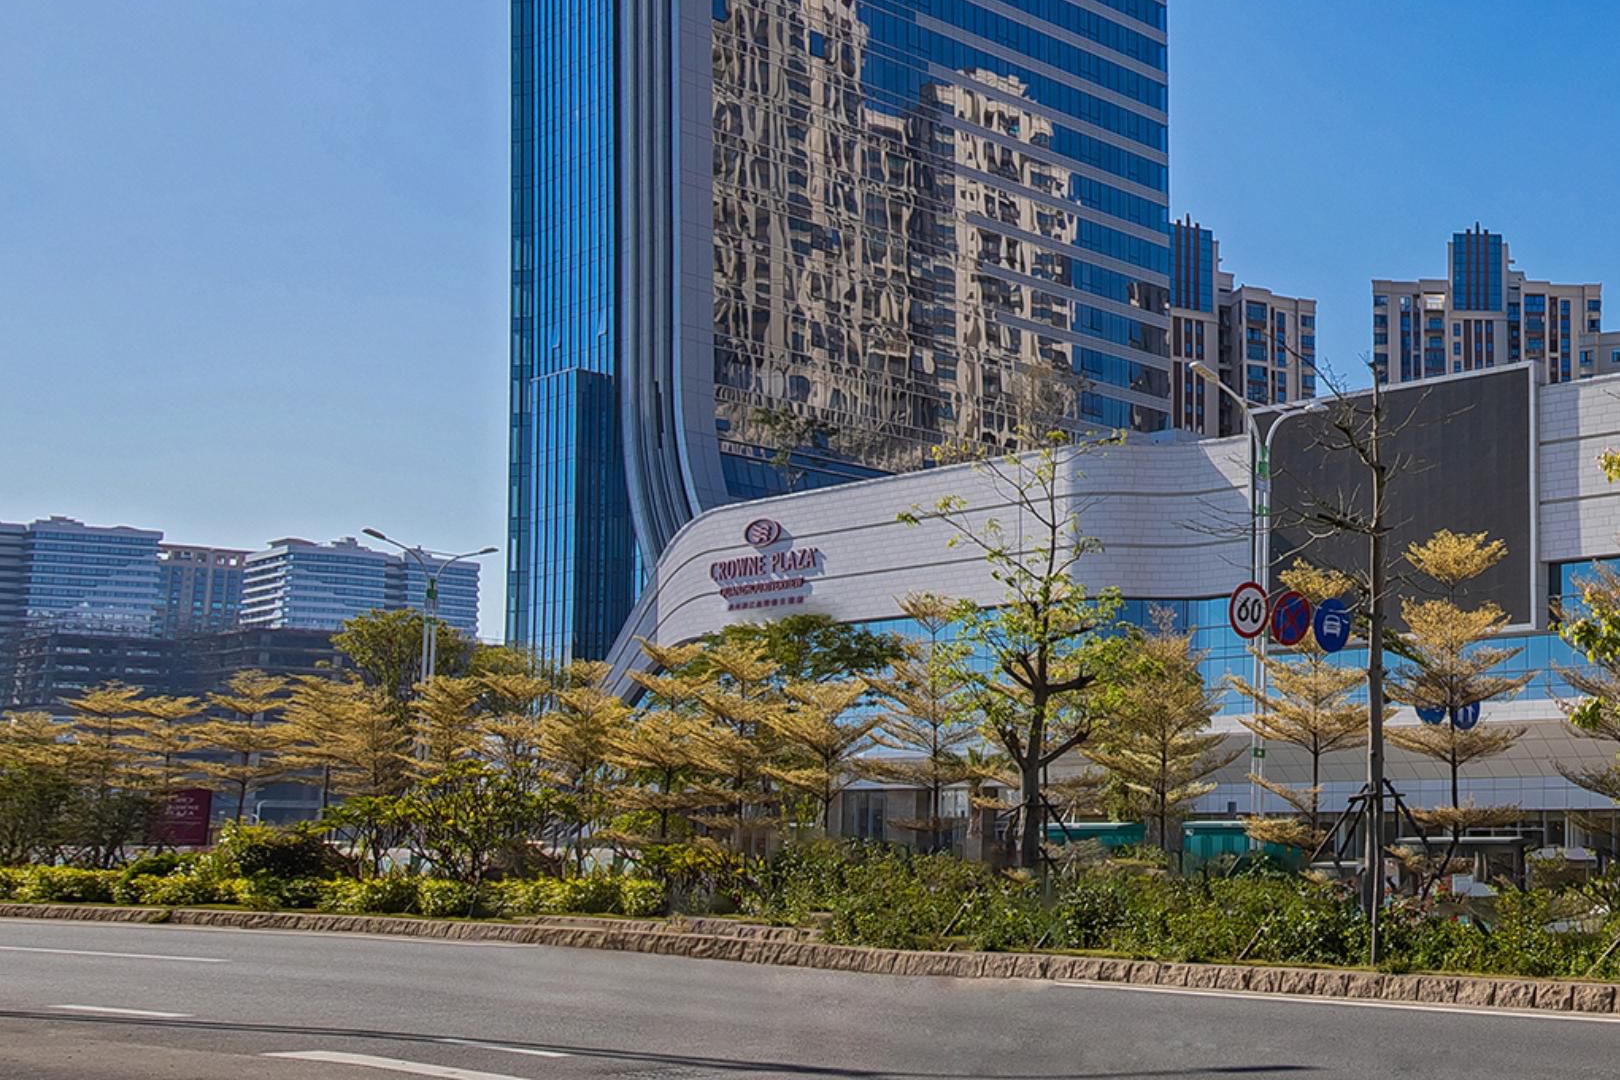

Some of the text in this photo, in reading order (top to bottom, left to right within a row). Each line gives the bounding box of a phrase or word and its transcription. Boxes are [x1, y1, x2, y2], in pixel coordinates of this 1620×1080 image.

[710, 548, 818, 580] CROWNE PLAZA
[1238, 597, 1262, 624] 60
